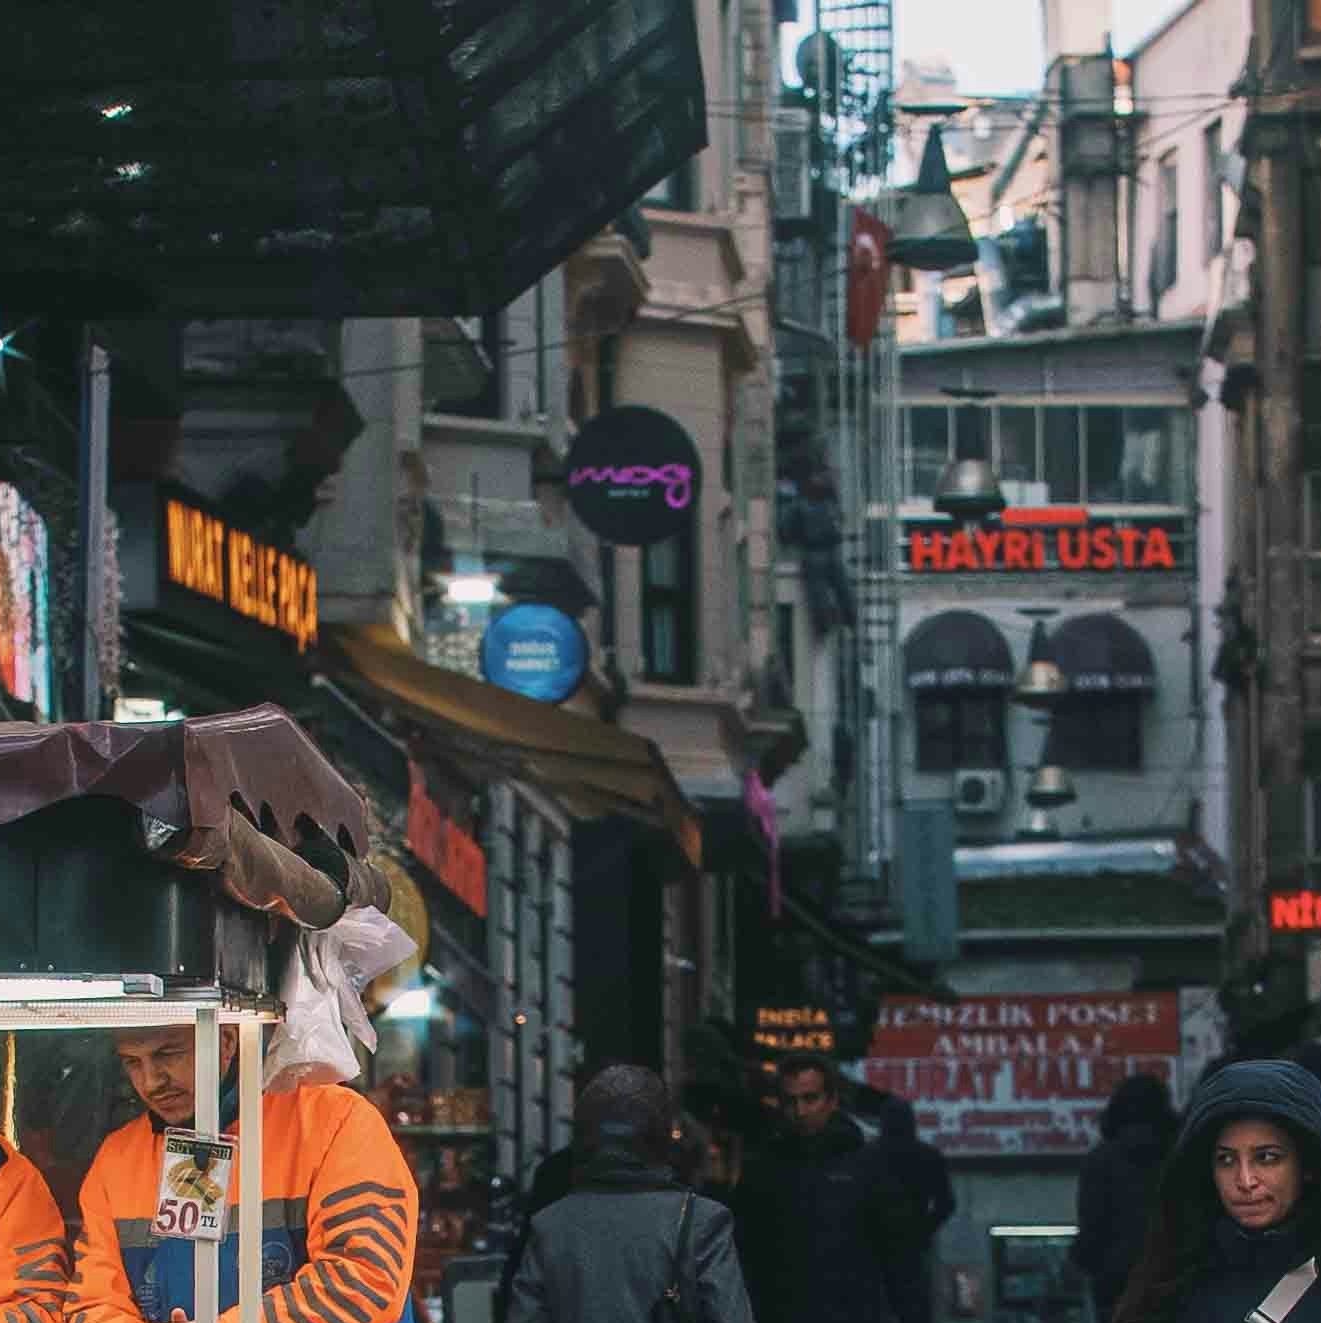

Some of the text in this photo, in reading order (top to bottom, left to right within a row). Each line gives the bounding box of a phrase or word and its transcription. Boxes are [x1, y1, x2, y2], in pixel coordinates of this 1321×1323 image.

[1057, 526, 1176, 570] USTA
[935, 1033, 1104, 1056] AMBALAJ
[155, 1199, 218, 1235] 50 TL
